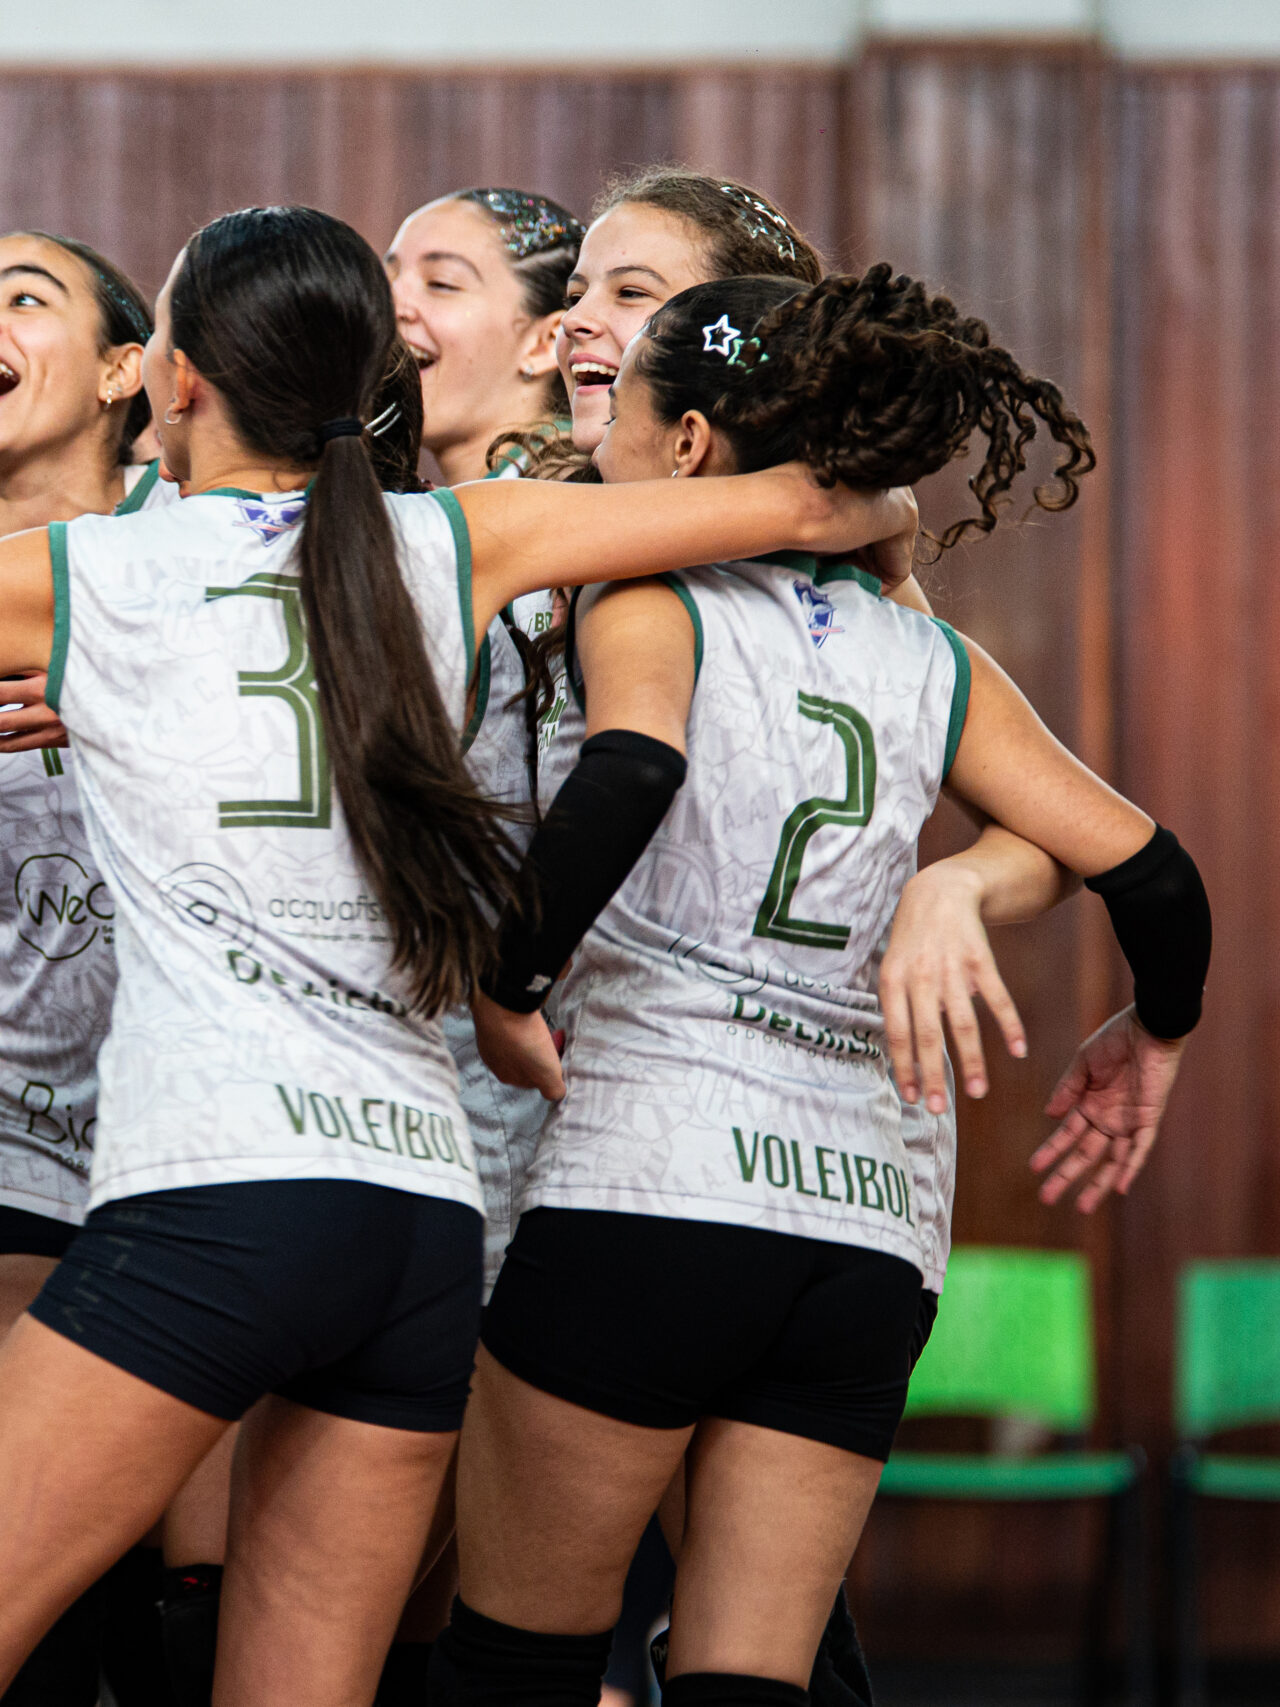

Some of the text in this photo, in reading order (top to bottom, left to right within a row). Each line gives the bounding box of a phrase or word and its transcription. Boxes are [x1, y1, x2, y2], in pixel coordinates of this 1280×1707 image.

[205, 572, 332, 828] 3
[753, 689, 878, 951] 2
[24, 881, 115, 927] WeC
[275, 1084, 473, 1172] VOLEIBOL
[732, 1126, 915, 1229] VOLEIBOL
